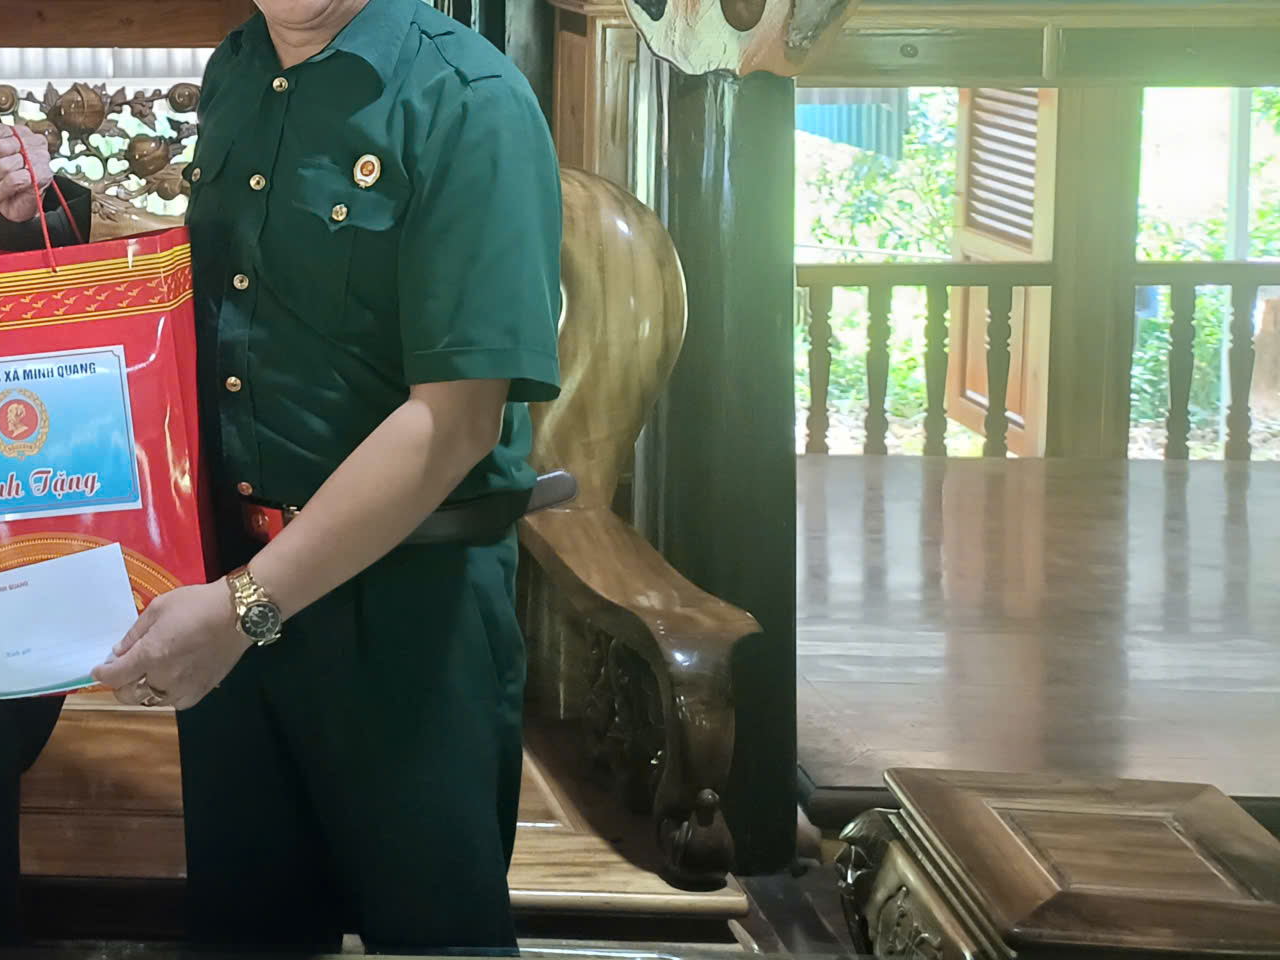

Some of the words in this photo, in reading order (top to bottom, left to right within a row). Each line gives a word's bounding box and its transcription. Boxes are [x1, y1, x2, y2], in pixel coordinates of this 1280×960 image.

[23, 367, 54, 381] MINH
[57, 362, 97, 378] QUANG
[29, 467, 101, 500] Tặng
